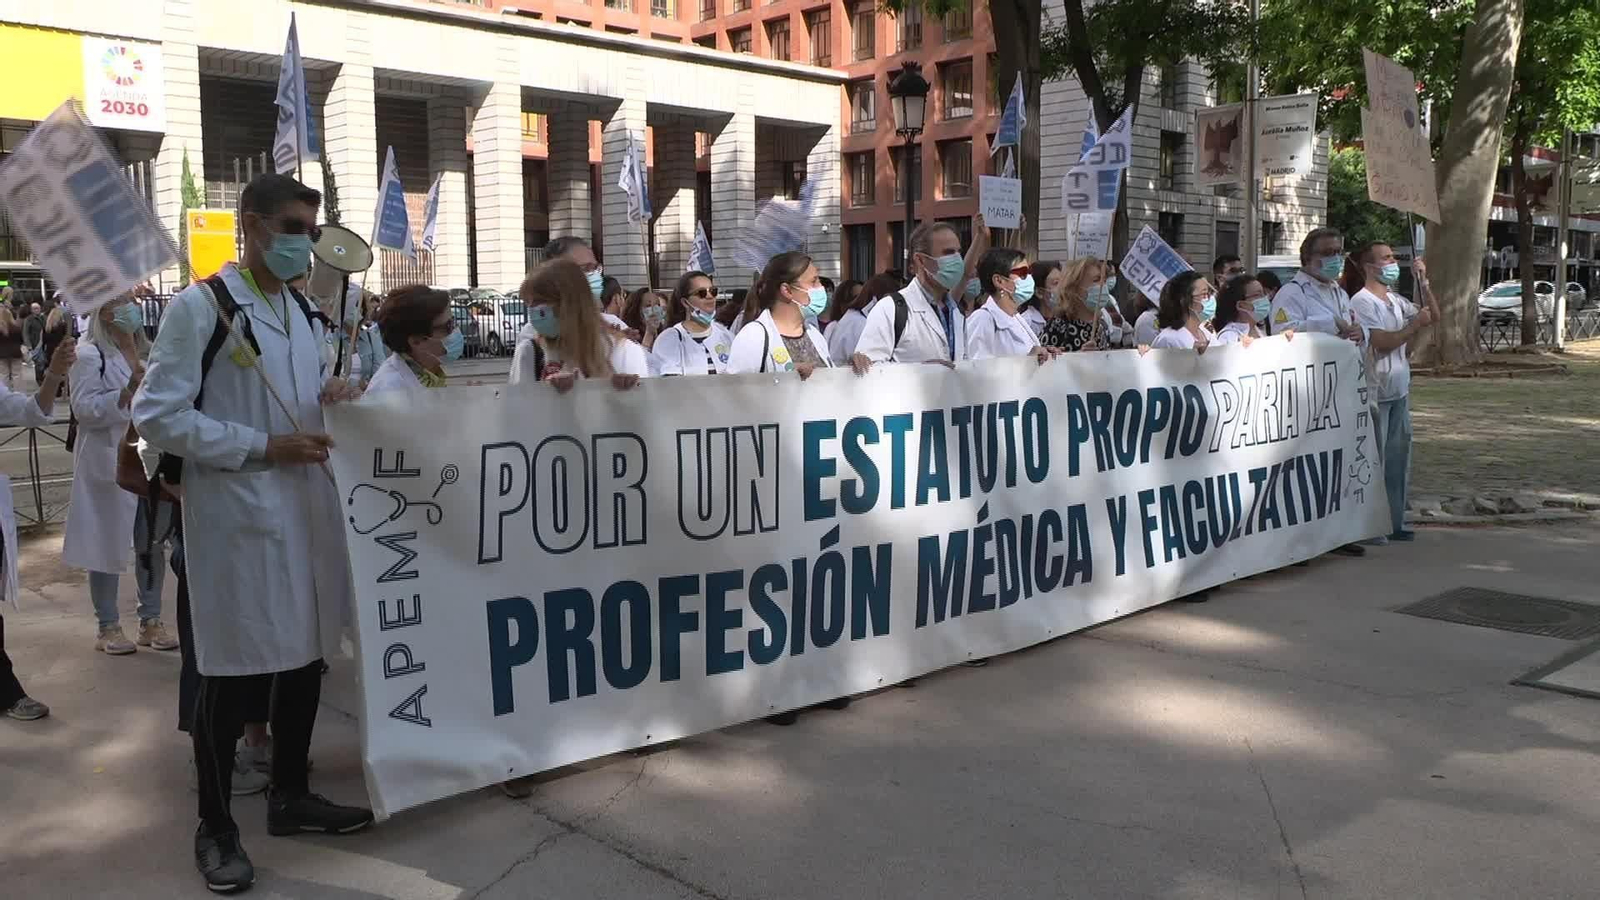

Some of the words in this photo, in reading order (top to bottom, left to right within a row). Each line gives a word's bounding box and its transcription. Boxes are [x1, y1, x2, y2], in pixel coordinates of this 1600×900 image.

[101, 99, 149, 116] 2030
[986, 206, 1016, 219] MATAR
[477, 432, 648, 564] POR
[676, 424, 780, 540] UN
[803, 397, 1050, 522] ESTATUTO
[1066, 383, 1208, 478] PROPIO
[1208, 367, 1299, 453] PARA
[1305, 361, 1341, 433] LA
[486, 524, 892, 717] PROFESIÓN
[914, 500, 1093, 629] MÉDICA
[1105, 495, 1127, 577] Y
[1137, 448, 1343, 568] FACULTATIVA
